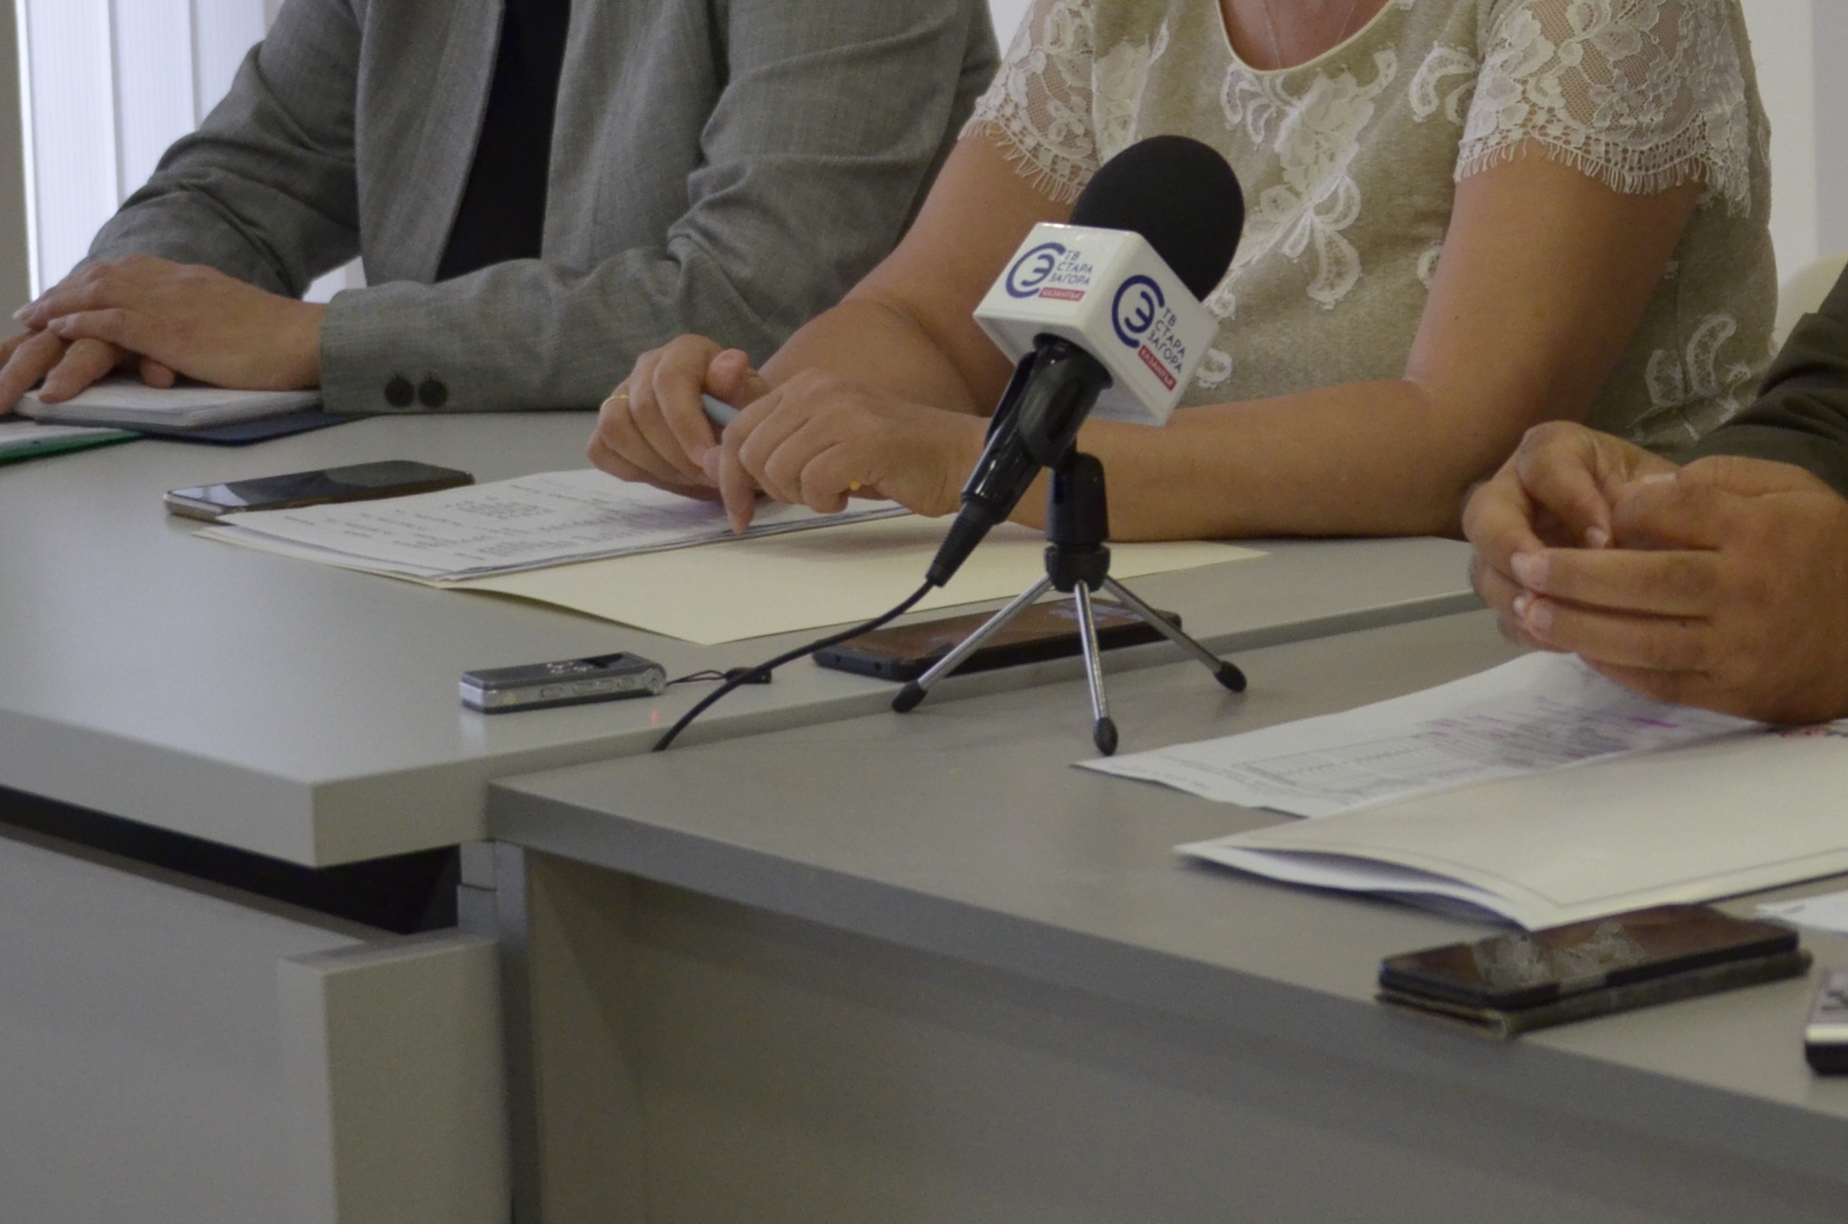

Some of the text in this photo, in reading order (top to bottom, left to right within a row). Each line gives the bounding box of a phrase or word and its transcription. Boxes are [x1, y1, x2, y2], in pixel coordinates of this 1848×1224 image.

[1065, 250, 1080, 261] ТВ
[1057, 261, 1093, 274] СТАРА
[1049, 272, 1090, 286] ЗАГОРА
[1163, 307, 1177, 327] ТВ
[1155, 319, 1186, 358] СТАРА
[1148, 330, 1183, 374] ЗАГОРА
